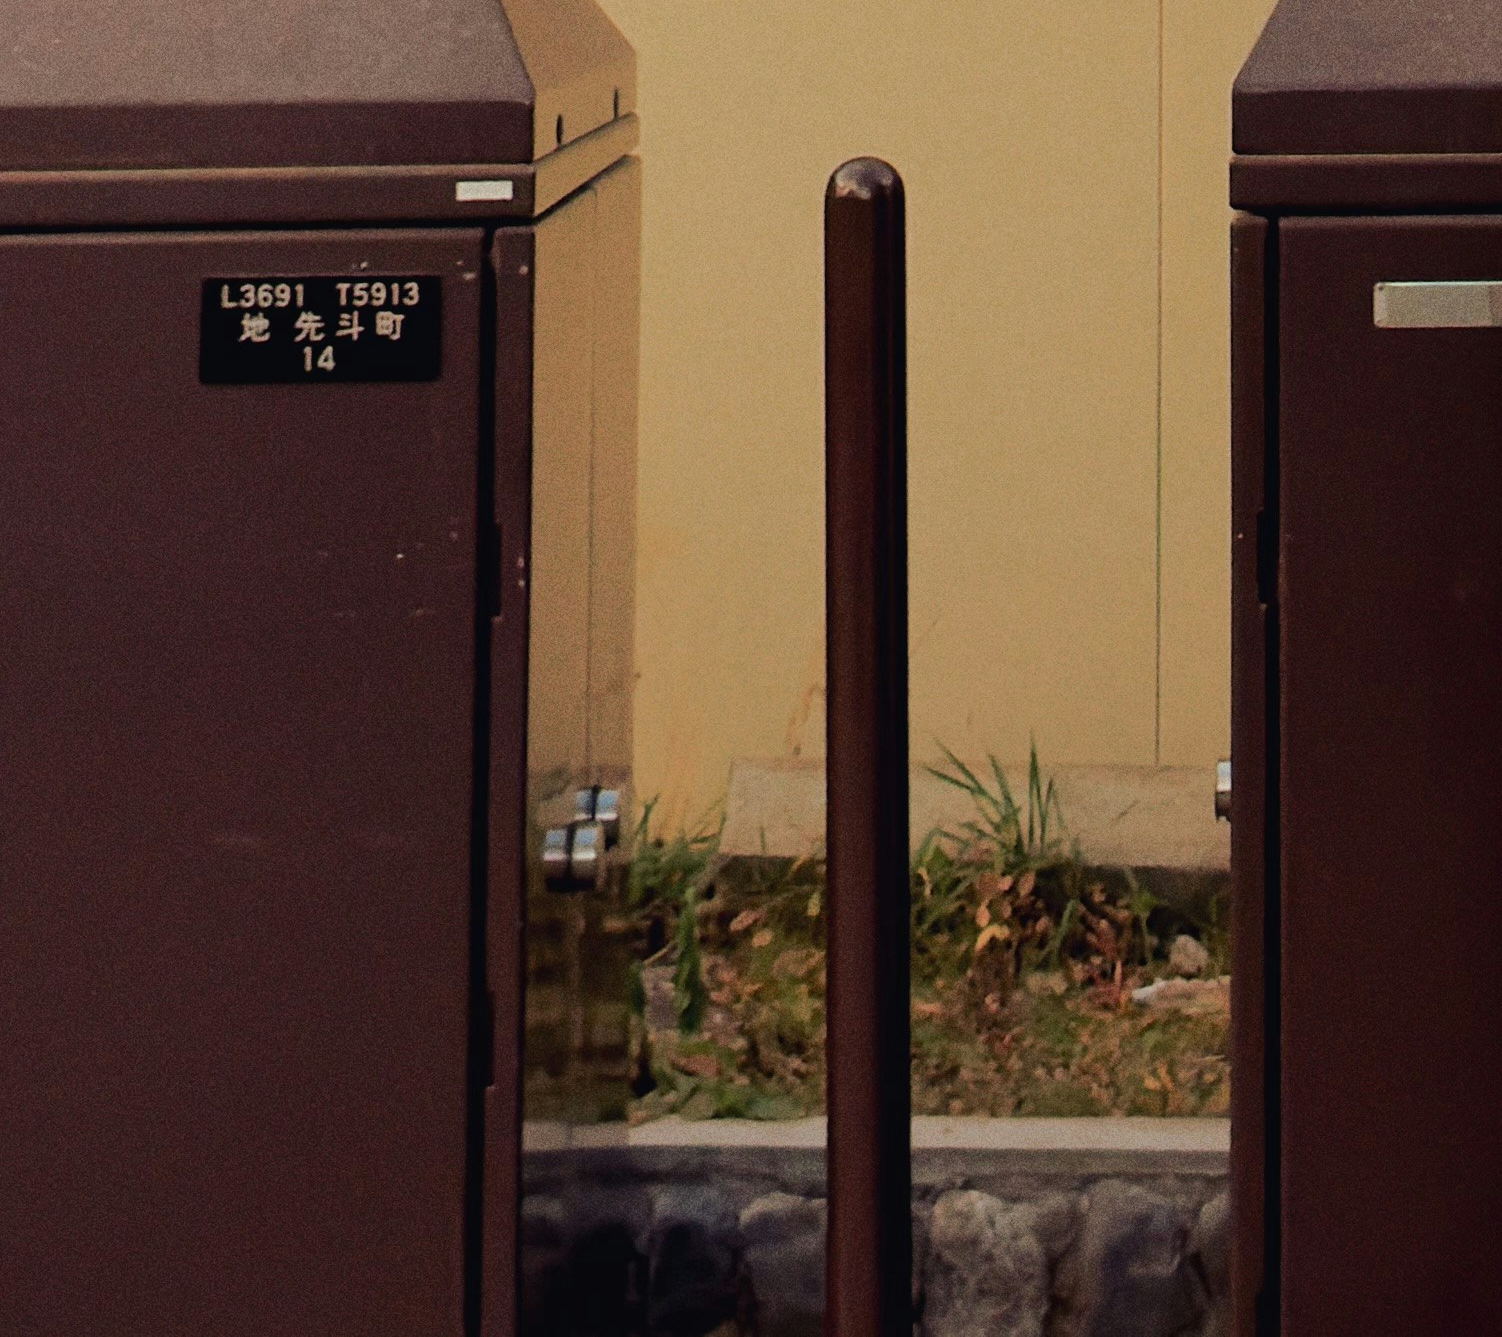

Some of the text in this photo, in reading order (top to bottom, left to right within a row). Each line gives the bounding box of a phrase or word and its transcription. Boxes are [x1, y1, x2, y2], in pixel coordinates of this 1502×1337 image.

[220, 281, 420, 309] L3691 T5913
[303, 345, 336, 372] 14
